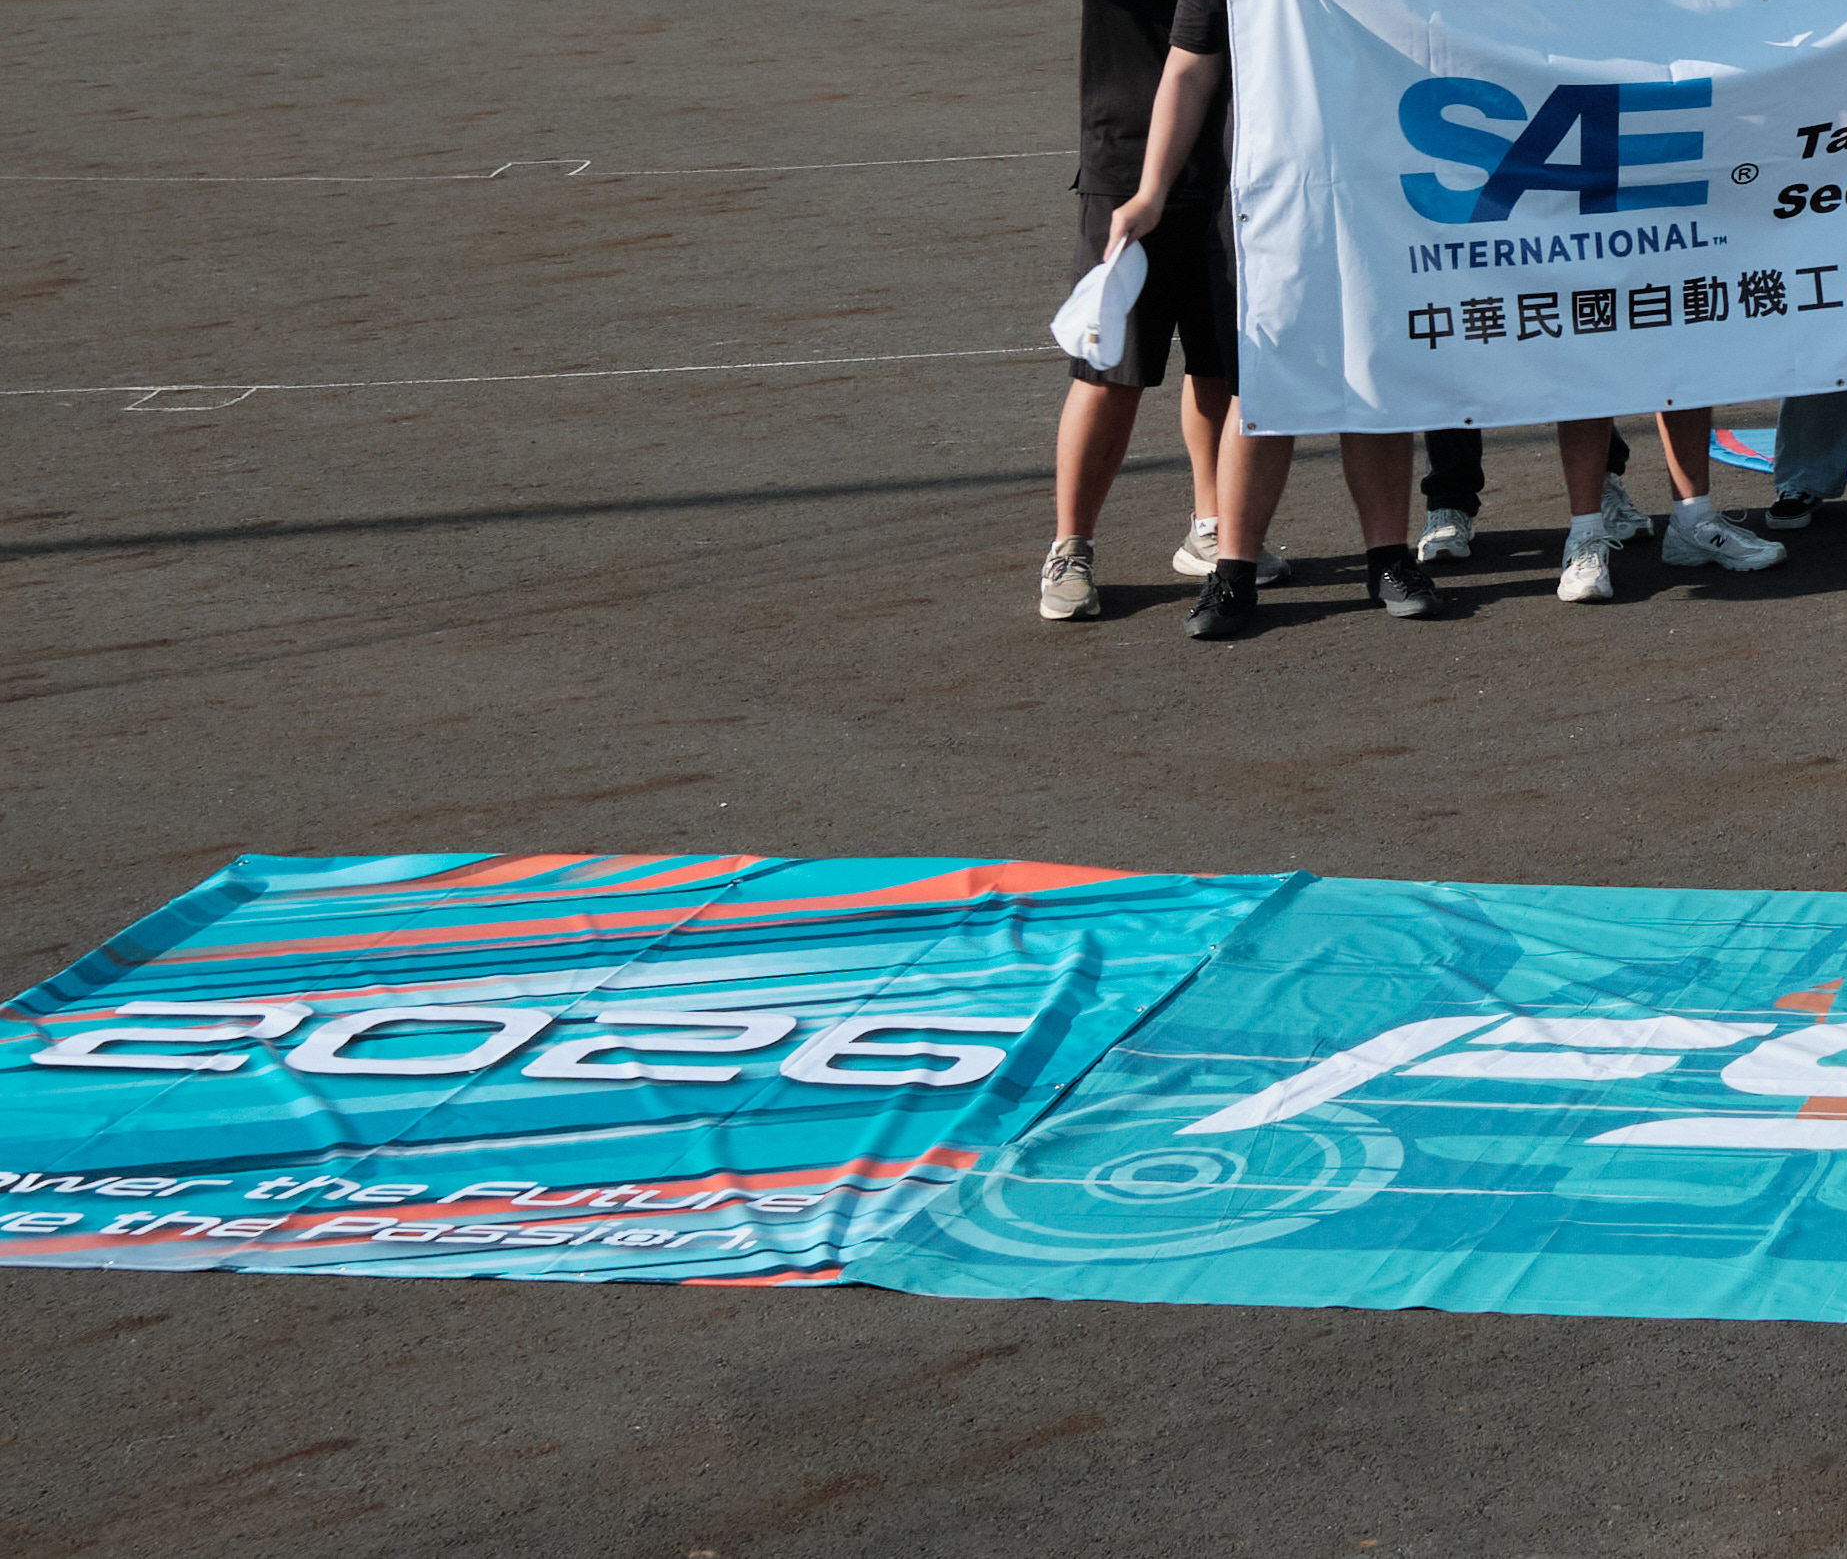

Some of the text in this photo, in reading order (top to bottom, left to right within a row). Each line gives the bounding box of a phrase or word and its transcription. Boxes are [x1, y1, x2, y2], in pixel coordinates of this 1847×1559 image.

[1398, 77, 1713, 224] SAE
[1409, 221, 1708, 273] INTERNATIONAL
[30, 999, 1036, 1088] 2026
[244, 1176, 428, 1203] the
[437, 1181, 830, 1213] Future
[101, 1210, 291, 1238] the
[297, 1216, 758, 1250] Passion.
